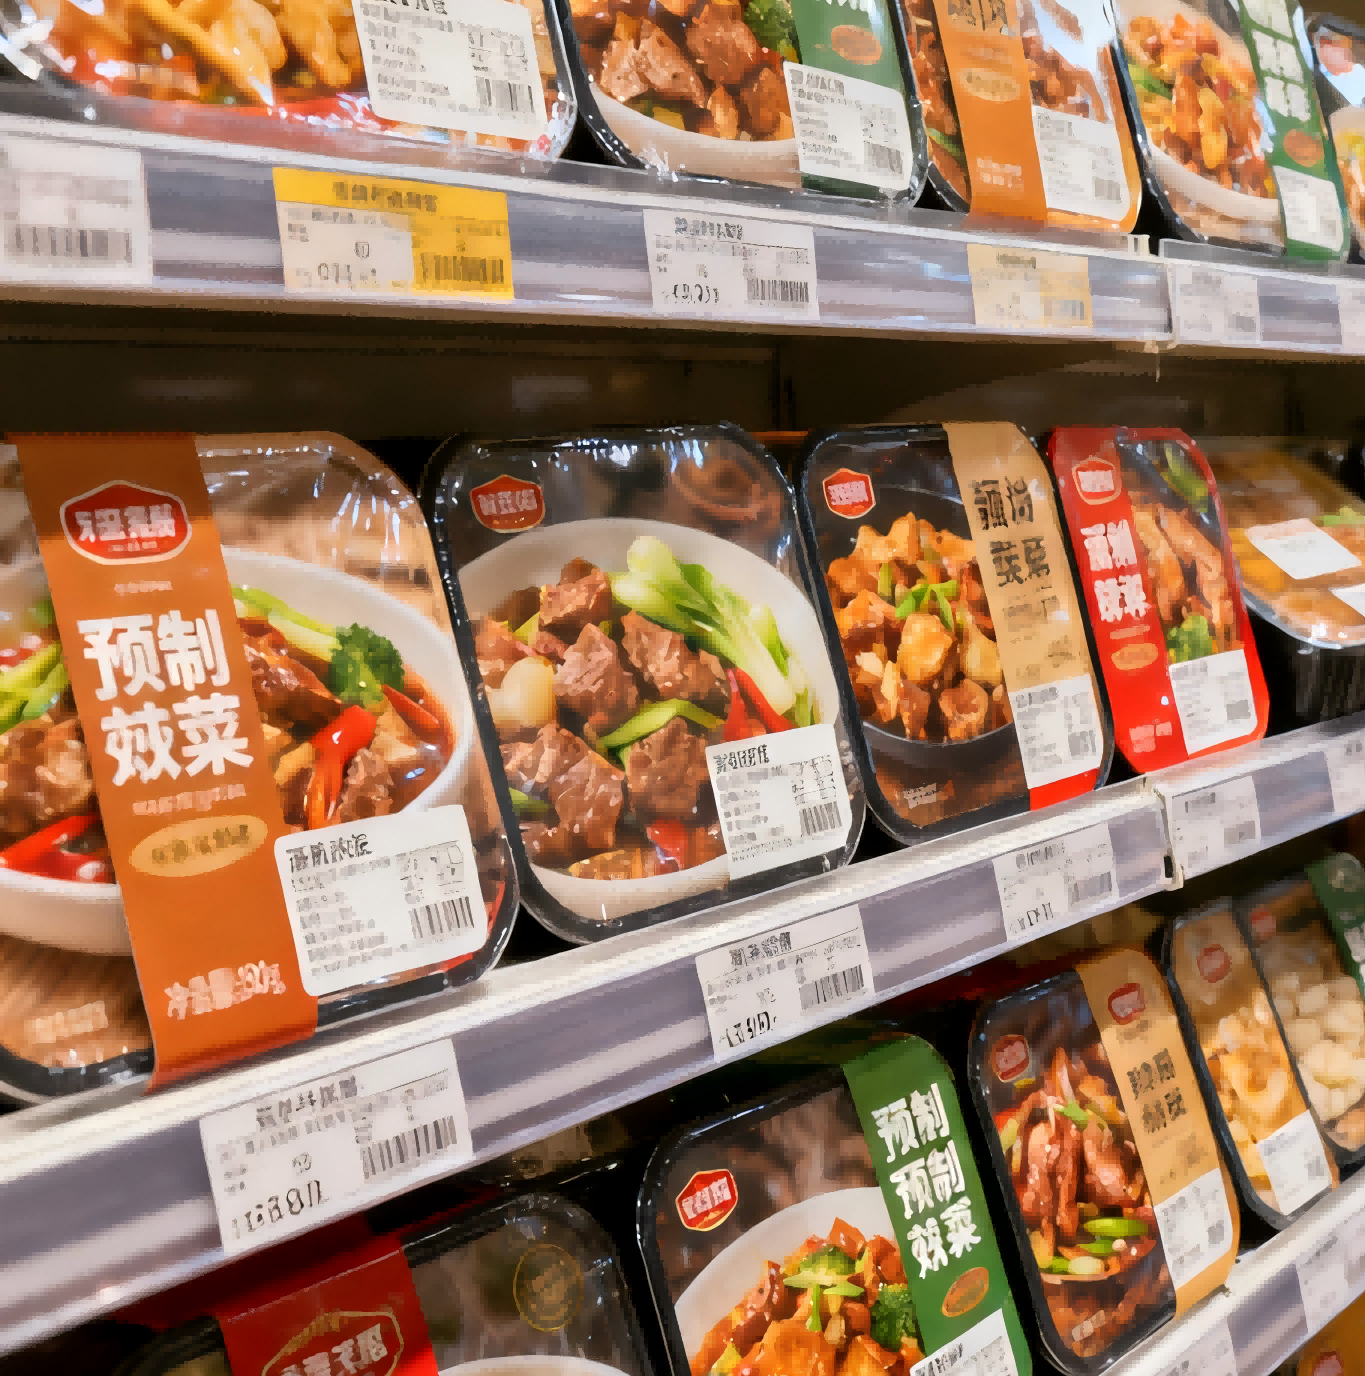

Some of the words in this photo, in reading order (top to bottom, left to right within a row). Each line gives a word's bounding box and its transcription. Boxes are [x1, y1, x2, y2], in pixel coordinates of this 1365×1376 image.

[77, 609, 230, 700] 预制
[871, 1083, 950, 1163] 预制
[890, 1140, 965, 1219] 预制
